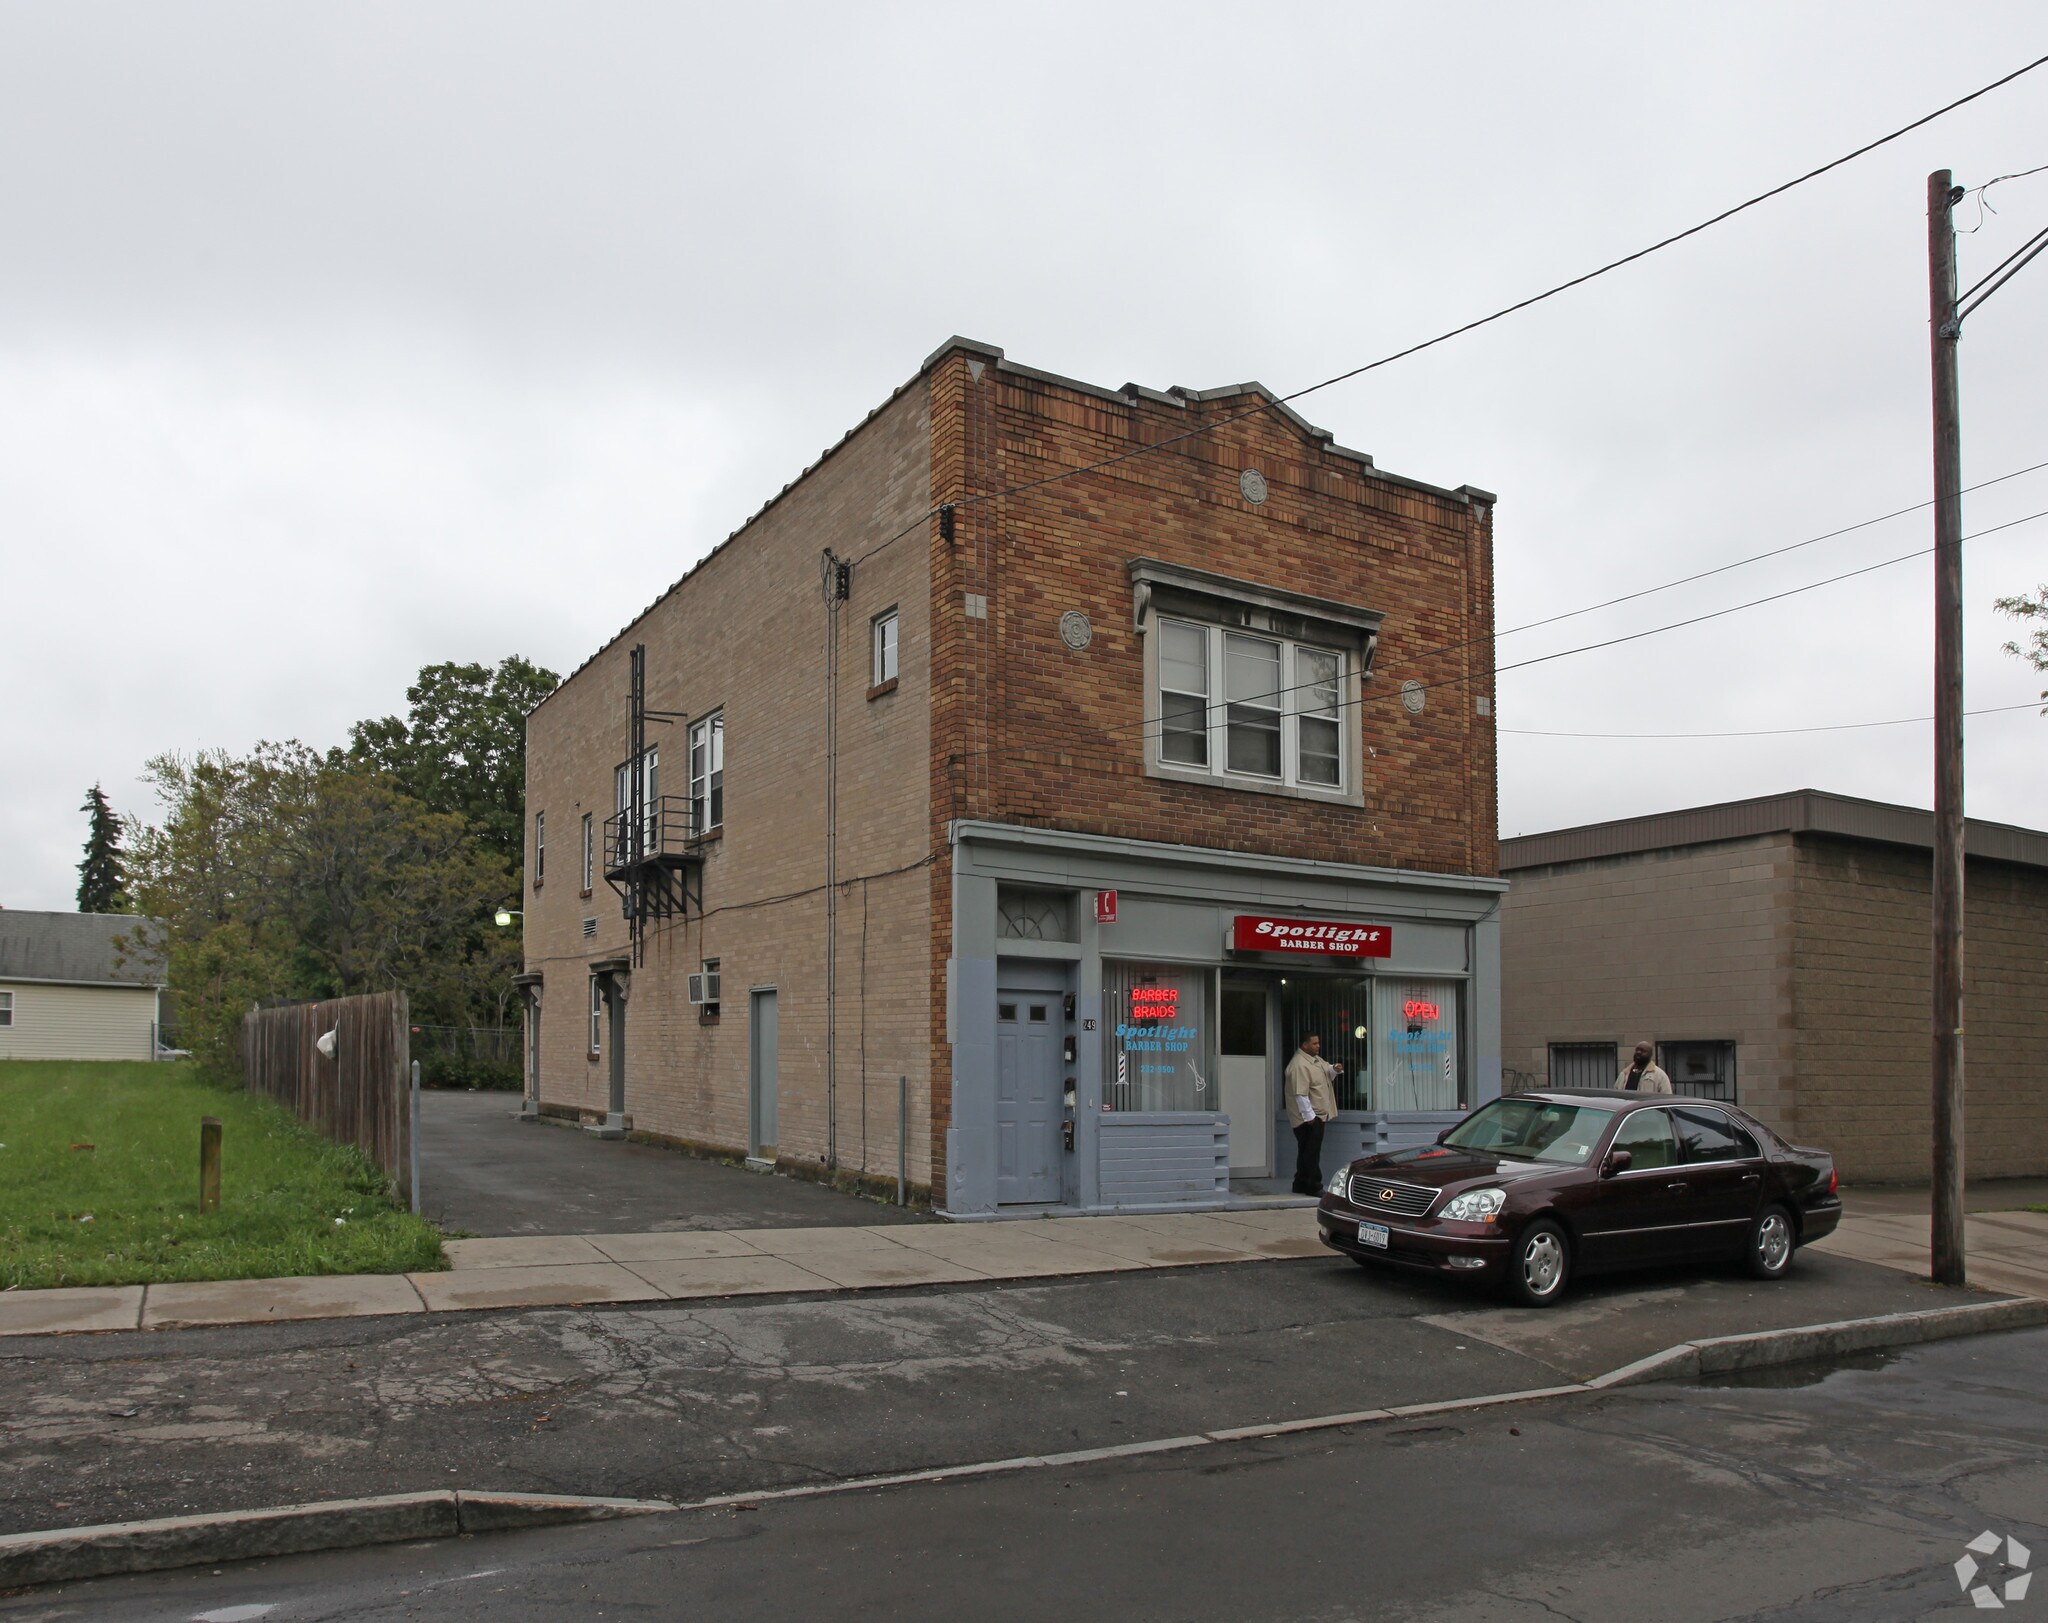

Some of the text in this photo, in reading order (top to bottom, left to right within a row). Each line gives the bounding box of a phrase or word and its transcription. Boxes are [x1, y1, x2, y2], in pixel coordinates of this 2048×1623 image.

[1255, 921, 1381, 942] Spotlight
[1280, 939, 1359, 952] BARBER SHOP
[1131, 988, 1179, 1001] BARBER
[1133, 1005, 1176, 1018] BRAIDS
[1405, 1000, 1439, 1020] OPEN
[1083, 1020, 1096, 1030] 249
[1115, 1024, 1197, 1041] Spotlight
[1125, 1041, 1188, 1052] BARBER SHOP
